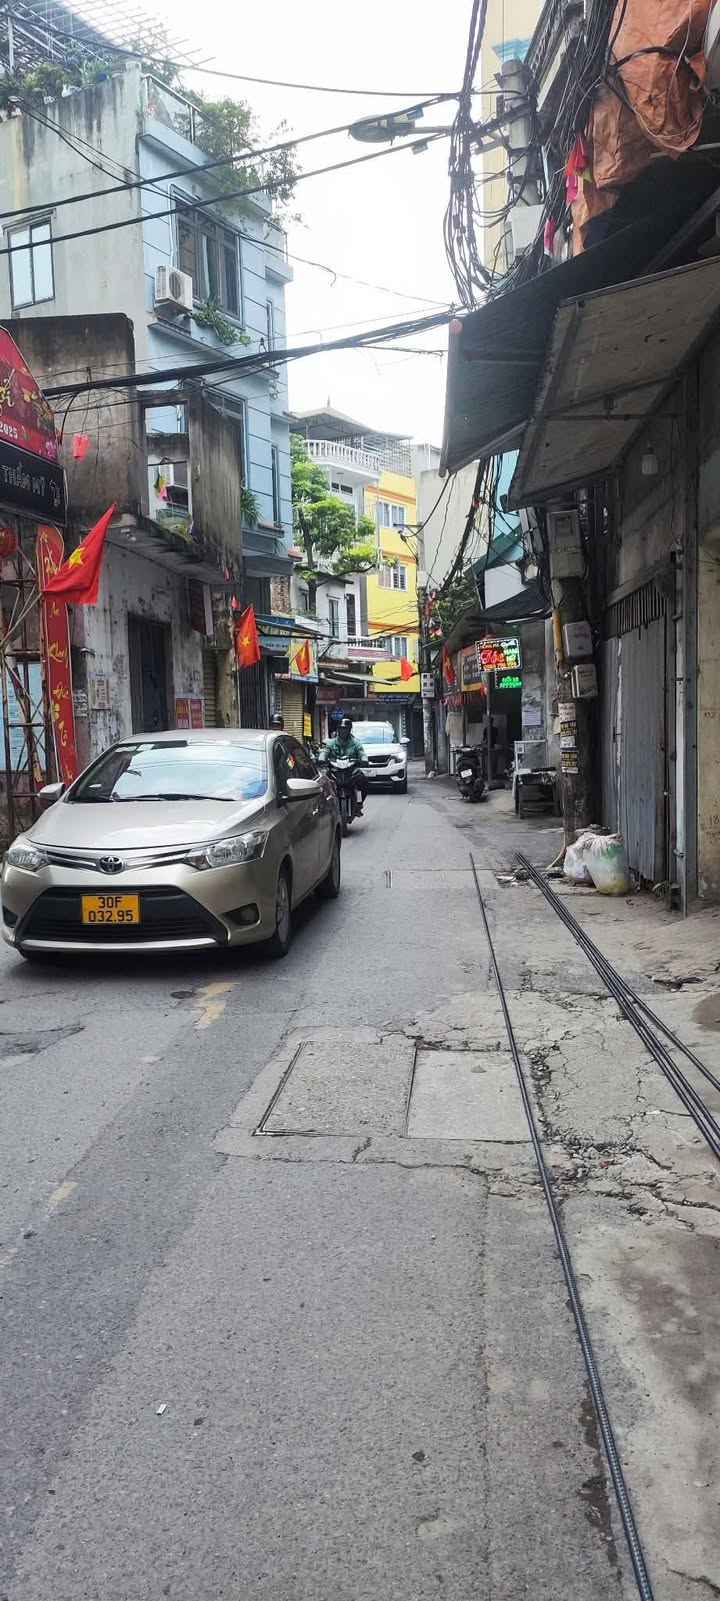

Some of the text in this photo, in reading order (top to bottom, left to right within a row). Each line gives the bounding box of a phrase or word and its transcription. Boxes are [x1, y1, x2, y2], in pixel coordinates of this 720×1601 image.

[0, 421, 18, 439] 2025
[98, 897, 122, 908] 30F
[88, 910, 133, 922] 032.95
